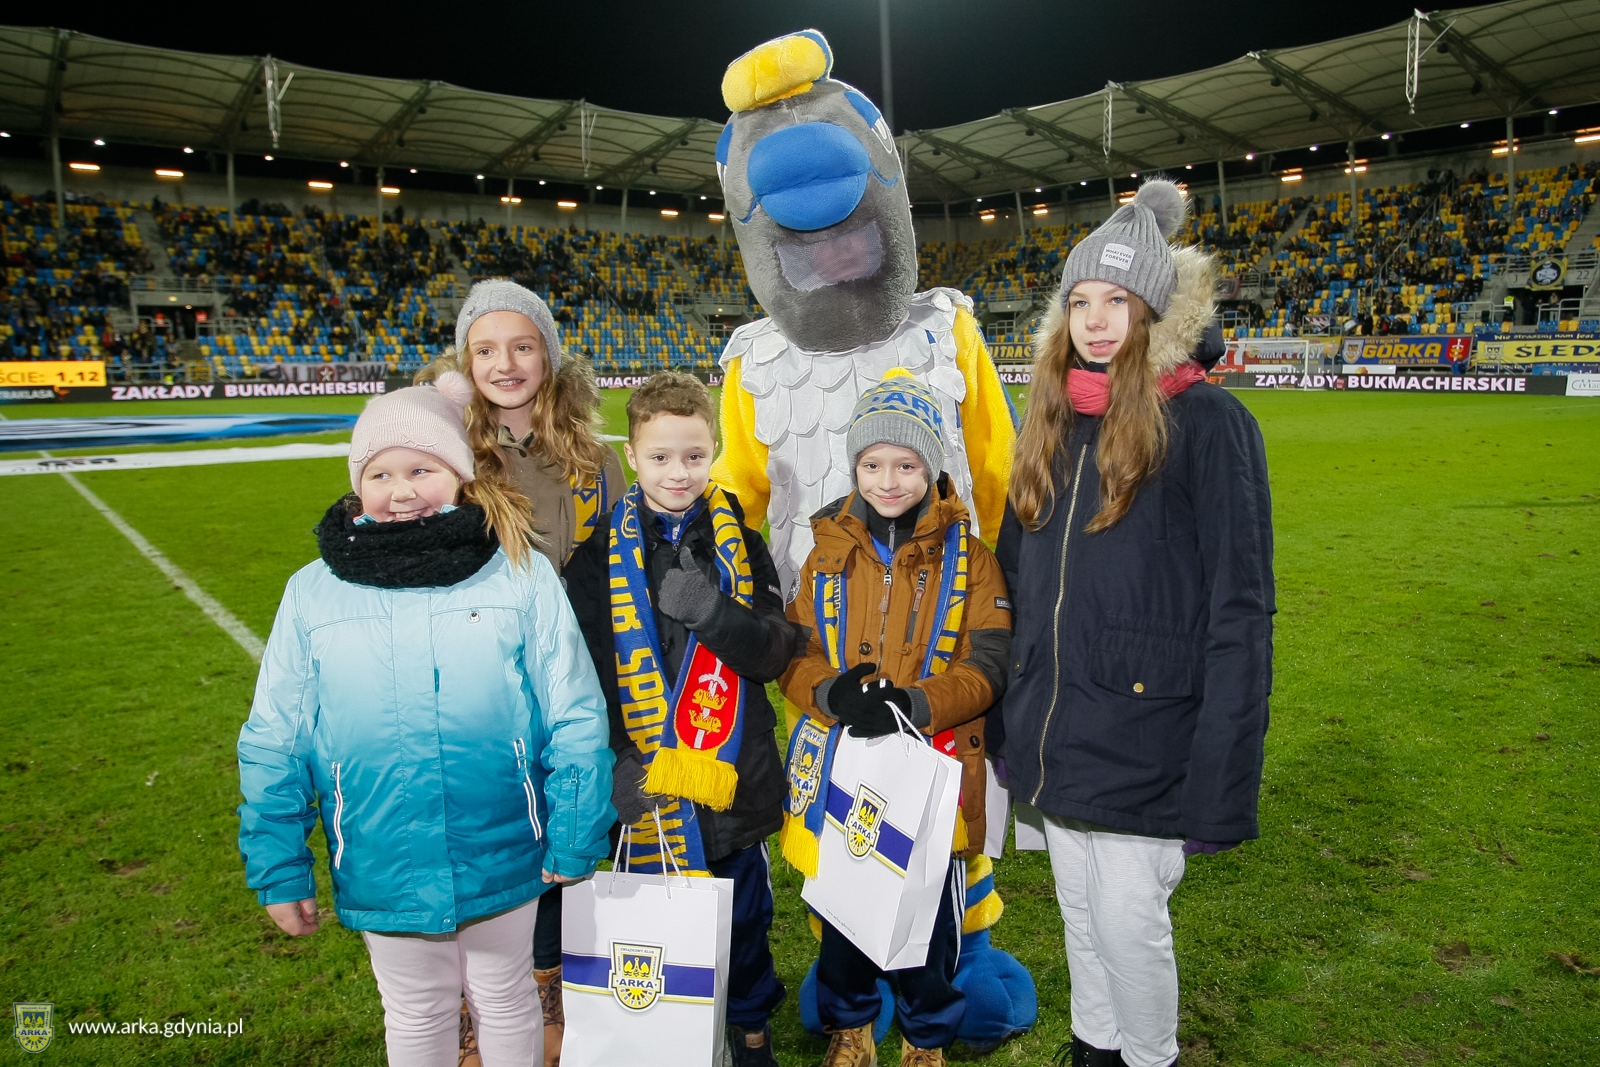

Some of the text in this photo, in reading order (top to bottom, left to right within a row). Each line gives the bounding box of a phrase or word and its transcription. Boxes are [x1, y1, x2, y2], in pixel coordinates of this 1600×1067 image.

[1105, 254, 1128, 263] FOREVER
[1576, 270, 1590, 280] 22
[1361, 342, 1443, 359] GÓRKA
[57, 372, 99, 384] 1,12
[1000, 373, 1034, 383] KŁAD
[1255, 374, 1338, 388] ZAKŁADY
[1347, 375, 1526, 392] BUKMACHERSKIE
[111, 381, 386, 400] ZAKŁADY BUKMACHERSKIE
[852, 820, 872, 840] ARKA
[619, 978, 654, 989] ARKA
